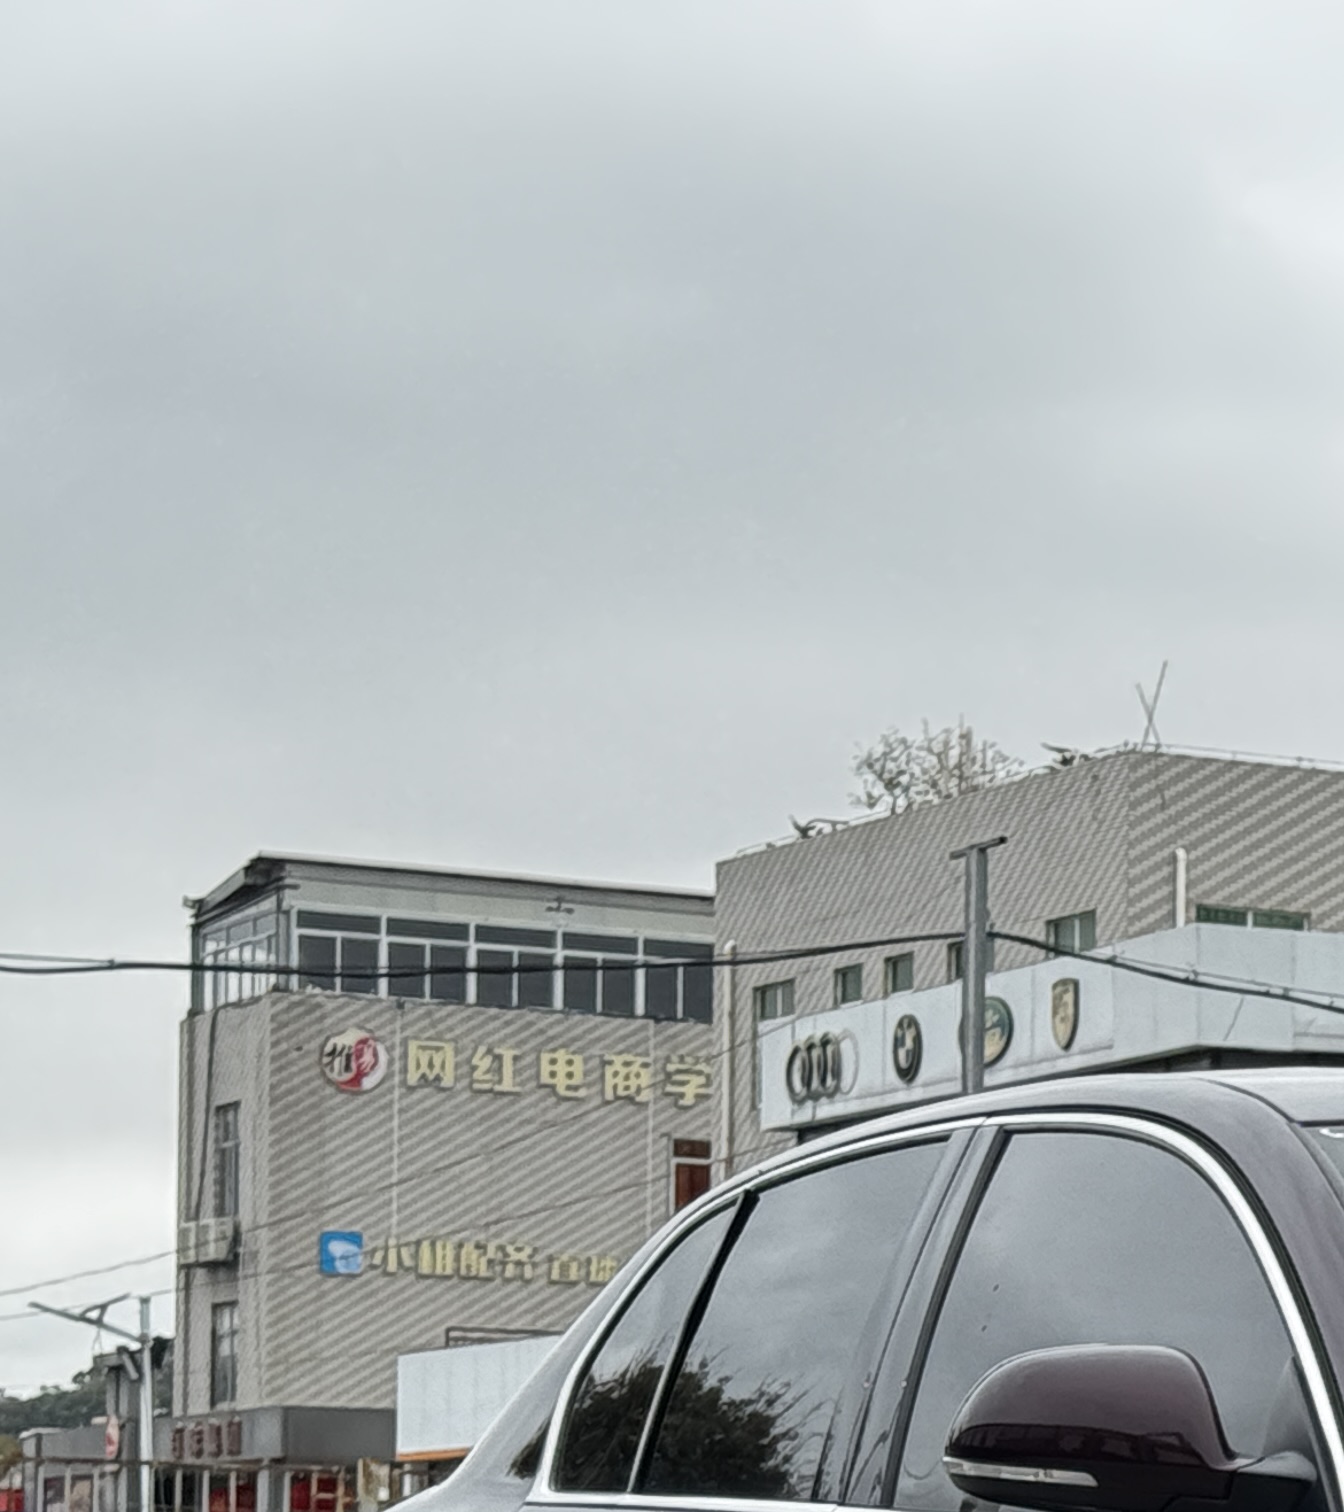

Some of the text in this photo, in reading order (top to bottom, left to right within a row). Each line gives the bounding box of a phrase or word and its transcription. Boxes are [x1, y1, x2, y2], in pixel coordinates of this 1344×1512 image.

[407, 1040, 713, 1107] 网红电商学
